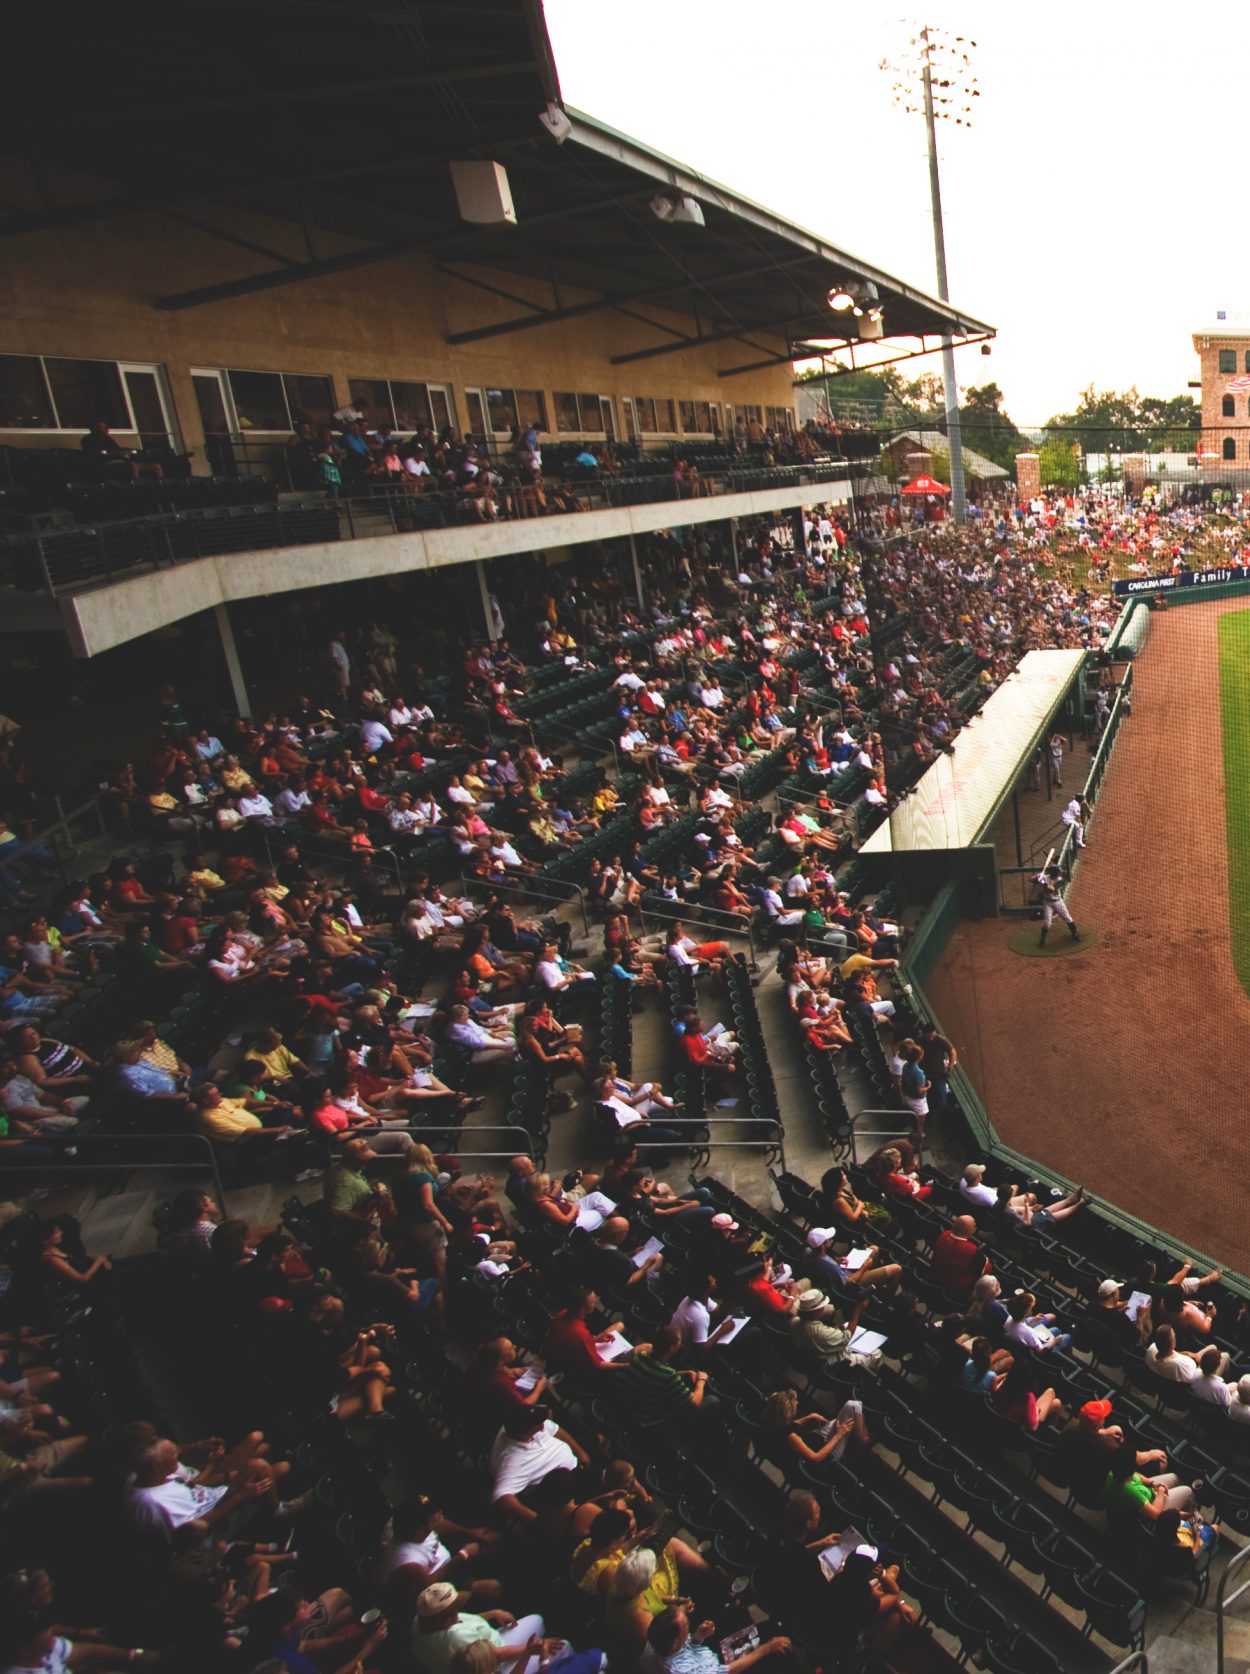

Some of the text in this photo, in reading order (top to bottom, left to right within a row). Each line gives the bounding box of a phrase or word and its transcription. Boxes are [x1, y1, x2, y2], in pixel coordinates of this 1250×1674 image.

[1193, 569, 1231, 584] Family
[1128, 577, 1175, 591] CAROLINA FIRST
